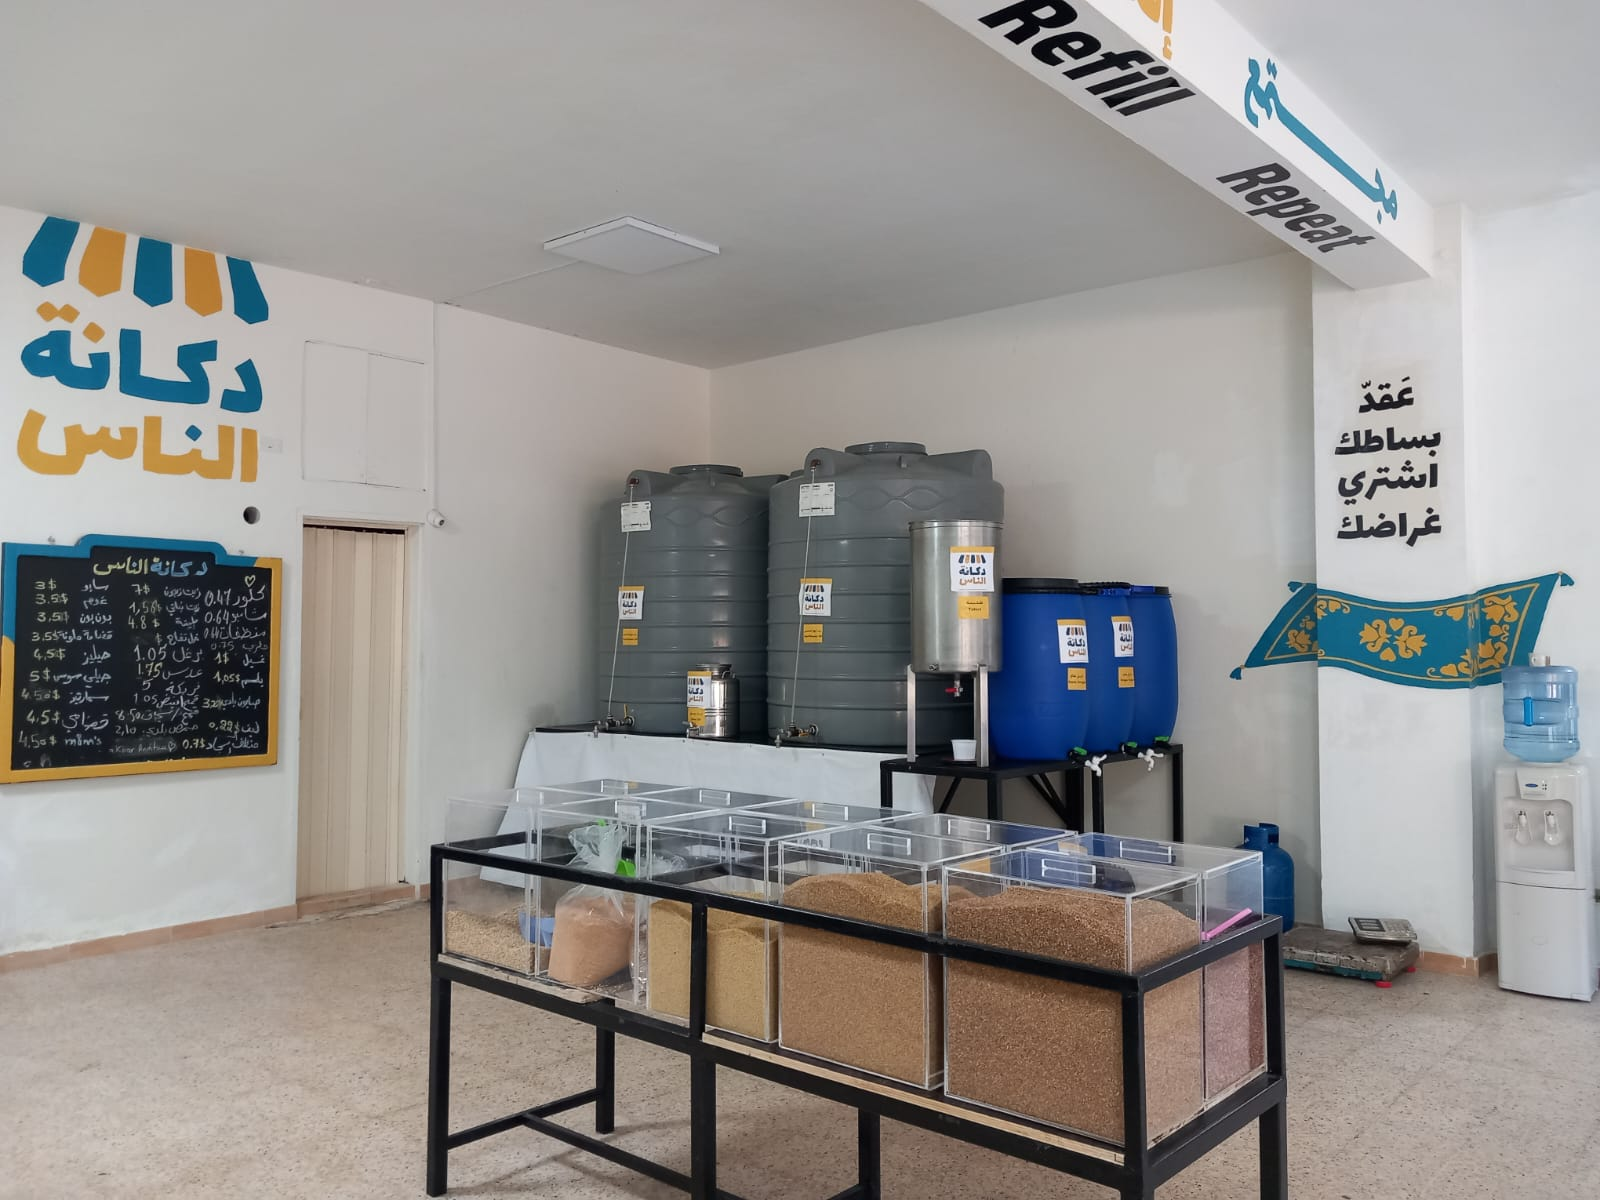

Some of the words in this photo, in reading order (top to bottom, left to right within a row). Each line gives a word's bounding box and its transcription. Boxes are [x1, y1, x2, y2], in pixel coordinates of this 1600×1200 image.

[978, 0, 1196, 116] Refill
[1215, 162, 1376, 253] Repeat
[21, 301, 262, 413] دكانة
[17, 408, 258, 483] الناس
[1335, 427, 1441, 457] بساطك
[1337, 460, 1438, 505] اشتري
[1337, 507, 1441, 547] غراضك
[93, 556, 148, 576] الناس
[959, 565, 986, 575] دكانة
[959, 577, 986, 585] الناس
[232, 584, 266, 608] كلور
[204, 609, 230, 625] 0.64
